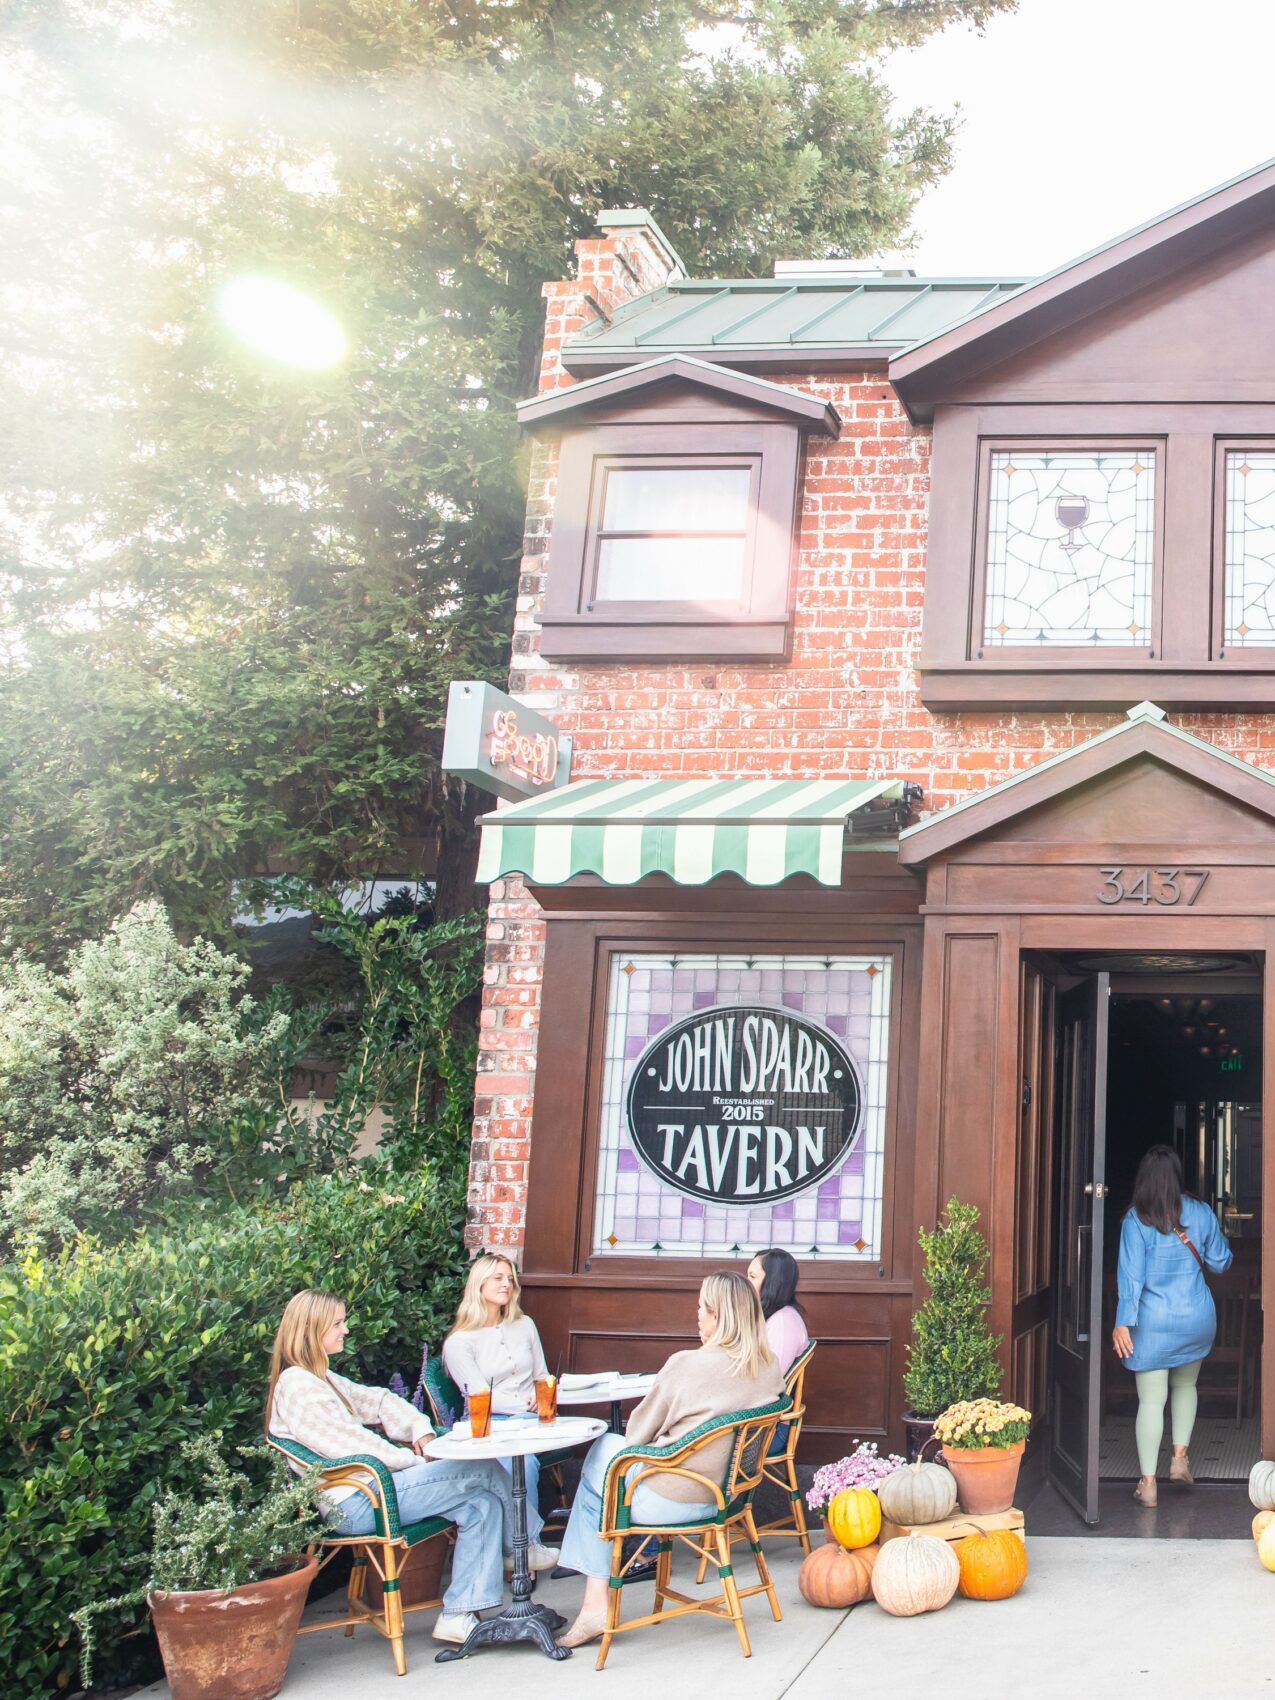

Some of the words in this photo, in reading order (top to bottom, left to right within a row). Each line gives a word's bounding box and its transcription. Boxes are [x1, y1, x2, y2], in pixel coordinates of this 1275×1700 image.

[1096, 866, 1210, 906] 3437
[659, 1017, 736, 1093] JOHN
[739, 1015, 831, 1094] SPARR
[721, 1106, 765, 1121] 2015
[657, 1124, 827, 1196] TAVERN
